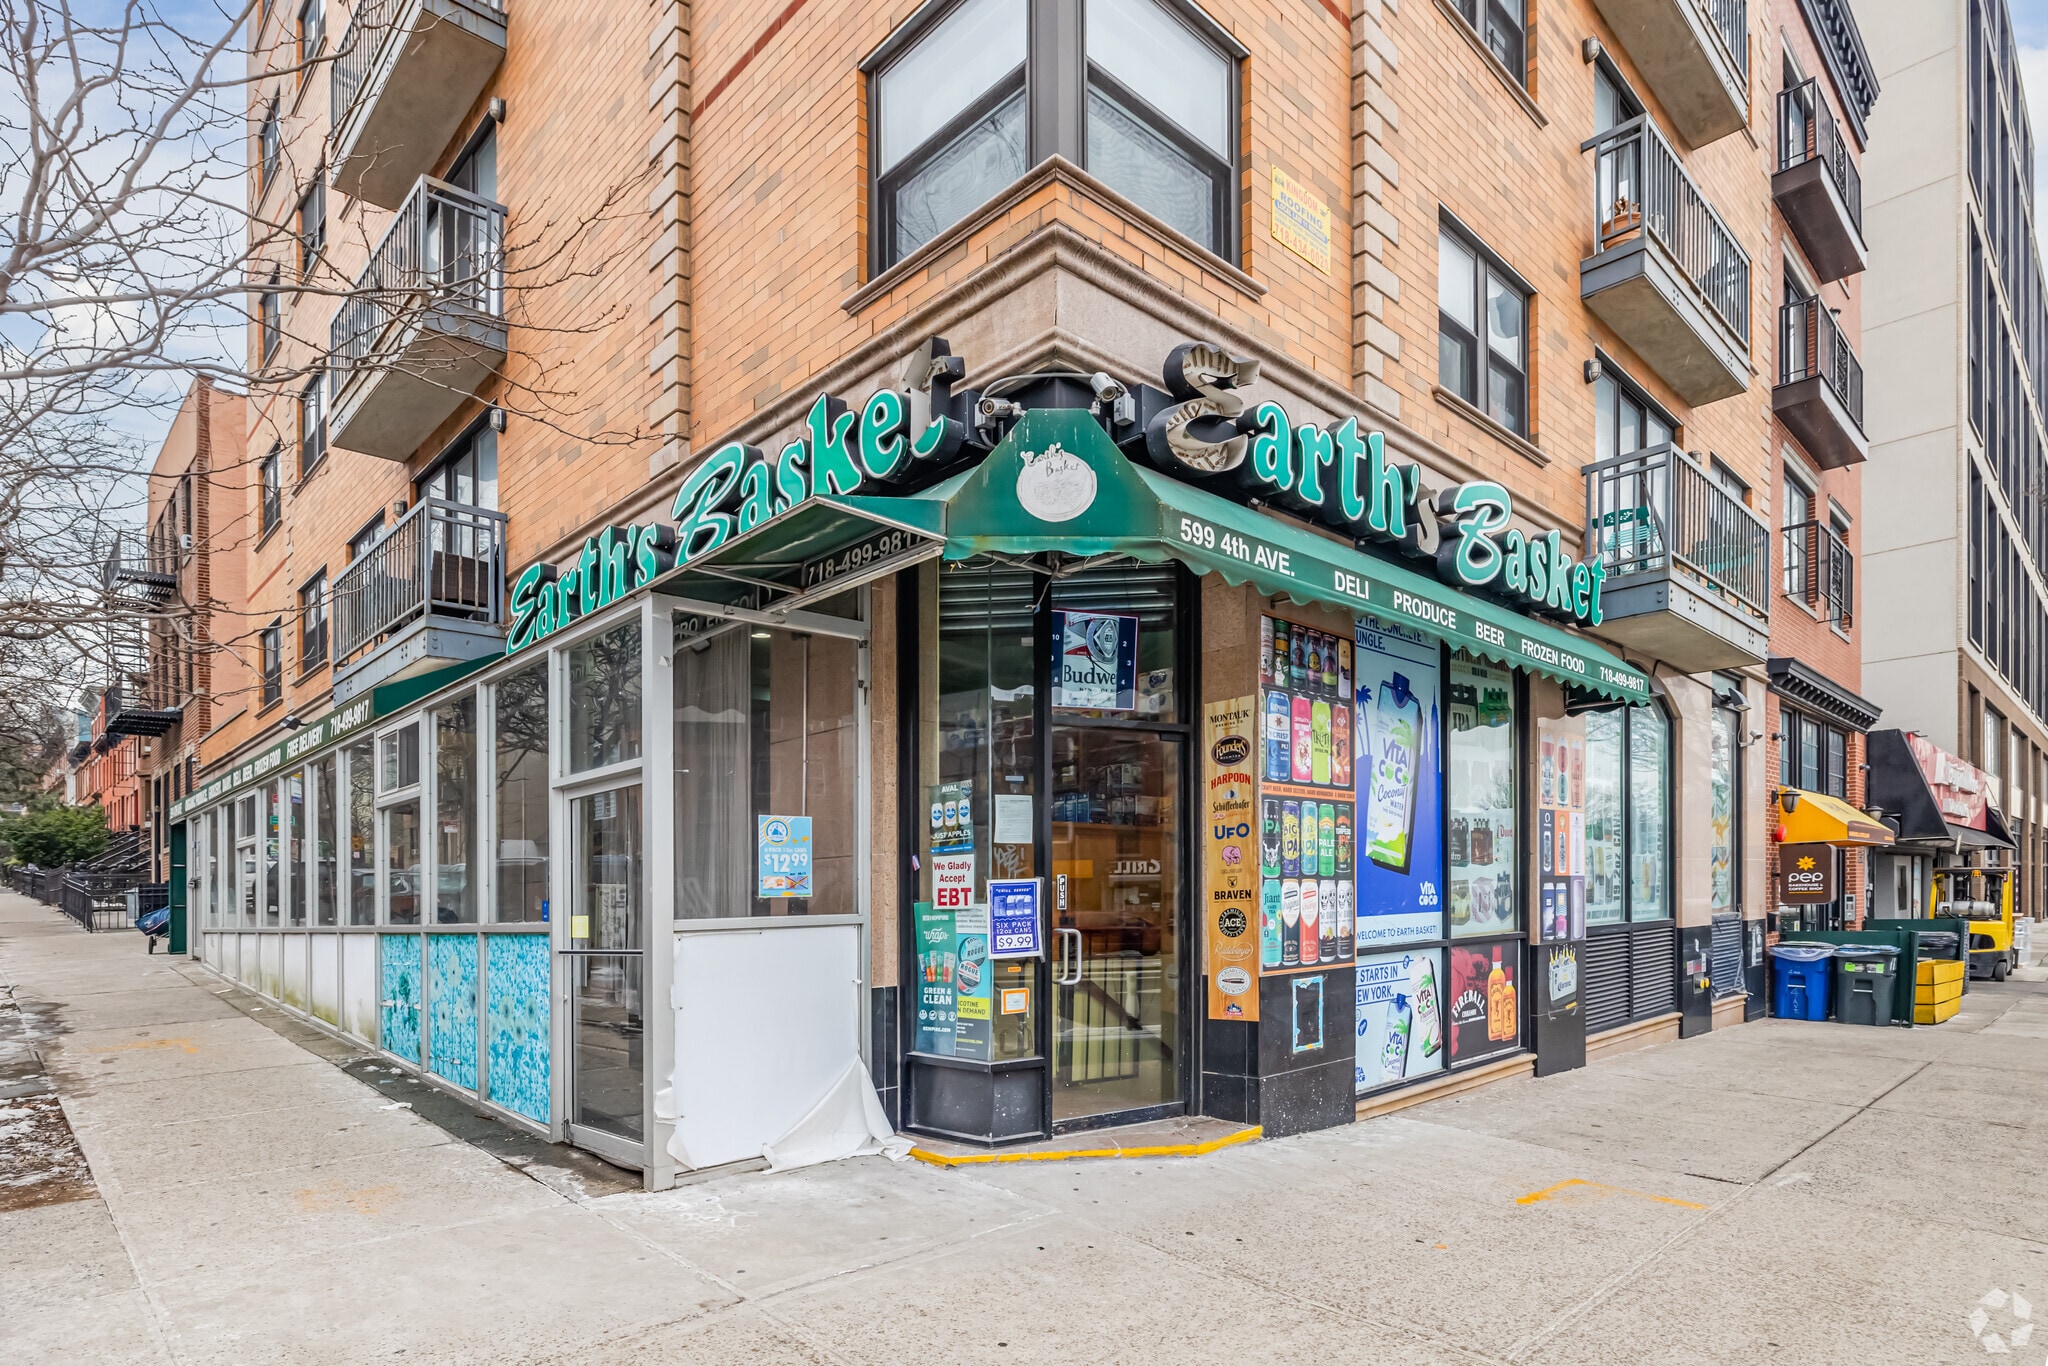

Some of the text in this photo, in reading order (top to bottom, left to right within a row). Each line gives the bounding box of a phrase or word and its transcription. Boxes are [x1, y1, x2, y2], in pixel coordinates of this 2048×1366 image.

[1286, 180, 1319, 213] KINGDOM
[1280, 191, 1323, 230] ROOFING
[1045, 459, 1079, 478] Basket
[1148, 342, 1607, 628] Earth's Basket
[504, 521, 665, 656] Earth's
[1180, 517, 1216, 549] 599
[1220, 529, 1251, 562] 4th
[1254, 544, 1295, 577] AVE.
[1334, 571, 1369, 600] DELI
[1393, 591, 1457, 630] PRODUCE
[1475, 621, 1505, 648] BEER
[1521, 638, 1558, 665] FROZEN
[1560, 651, 1585, 674] FOOD
[1599, 666, 1644, 692] 718-499-9817
[1356, 630, 1385, 651] UNGLE.
[1210, 709, 1249, 724] MONTAUK
[286, 737, 299, 760] FREE
[298, 723, 324, 754] DELIVERY
[1216, 740, 1246, 760] Founders
[1383, 737, 1408, 768] VITA
[1211, 772, 1251, 790] HARPOON
[941, 784, 959, 793] AVAL
[1390, 800, 1404, 811] WATER
[933, 829, 971, 839] JUST APPLES
[1214, 823, 1250, 840] UFO
[1262, 820, 1280, 834] IPA
[1283, 825, 1298, 836] BIG
[1318, 838, 1334, 847] PALE
[1320, 849, 1333, 857] ALE
[934, 862, 972, 871] We Gladly
[939, 874, 965, 884] Accept
[1788, 872, 1823, 883] pep
[1214, 889, 1252, 900] BRAVEN
[1420, 881, 1436, 895] VITA
[937, 887, 972, 906] EBT
[1264, 893, 1280, 905] Jiant
[1418, 894, 1438, 906] COCO
[1224, 918, 1242, 927] ACE
[1388, 927, 1395, 937] TO
[1396, 925, 1415, 936] EARTH
[1415, 924, 1438, 935] BASKET!
[998, 936, 1032, 948] $9.99
[968, 946, 984, 956] ROGUE
[960, 963, 979, 975] ROGUE
[1360, 965, 1398, 983] STARTS IN
[946, 987, 952, 995] &
[1357, 985, 1395, 1002] EW YORK.
[1416, 989, 1431, 1004] VITA
[923, 994, 952, 1005] CLEAN
[1451, 990, 1486, 1018] FIREBALL
[963, 1007, 985, 1015] DEMAND
[1389, 1031, 1403, 1046] VITA
